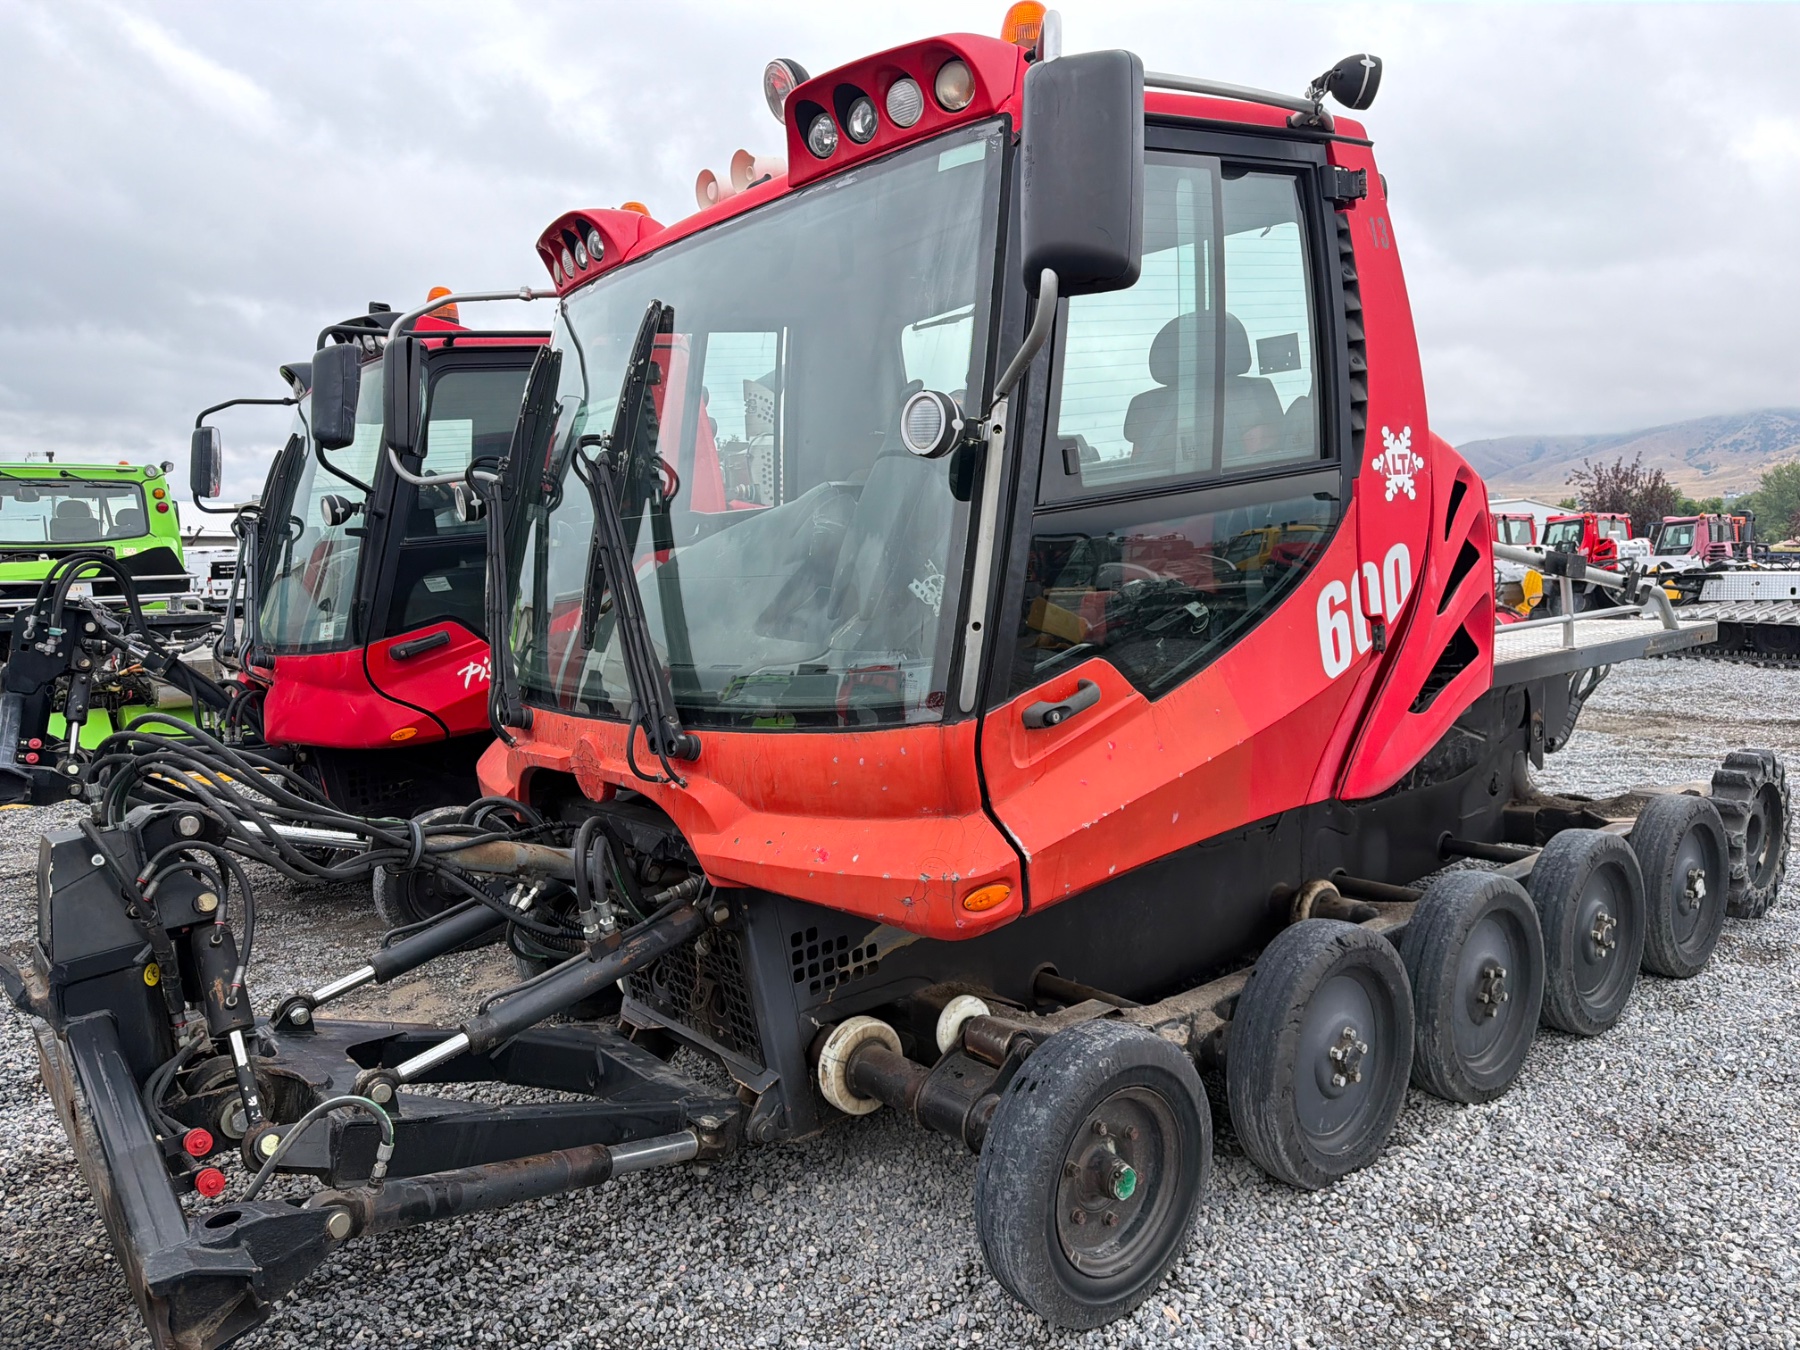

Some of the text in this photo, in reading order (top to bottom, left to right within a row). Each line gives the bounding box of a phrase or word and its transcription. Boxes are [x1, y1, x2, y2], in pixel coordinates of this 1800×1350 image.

[1368, 216, 1389, 250] 13
[1380, 453, 1418, 476] ALTA
[1316, 542, 1412, 680] 600
